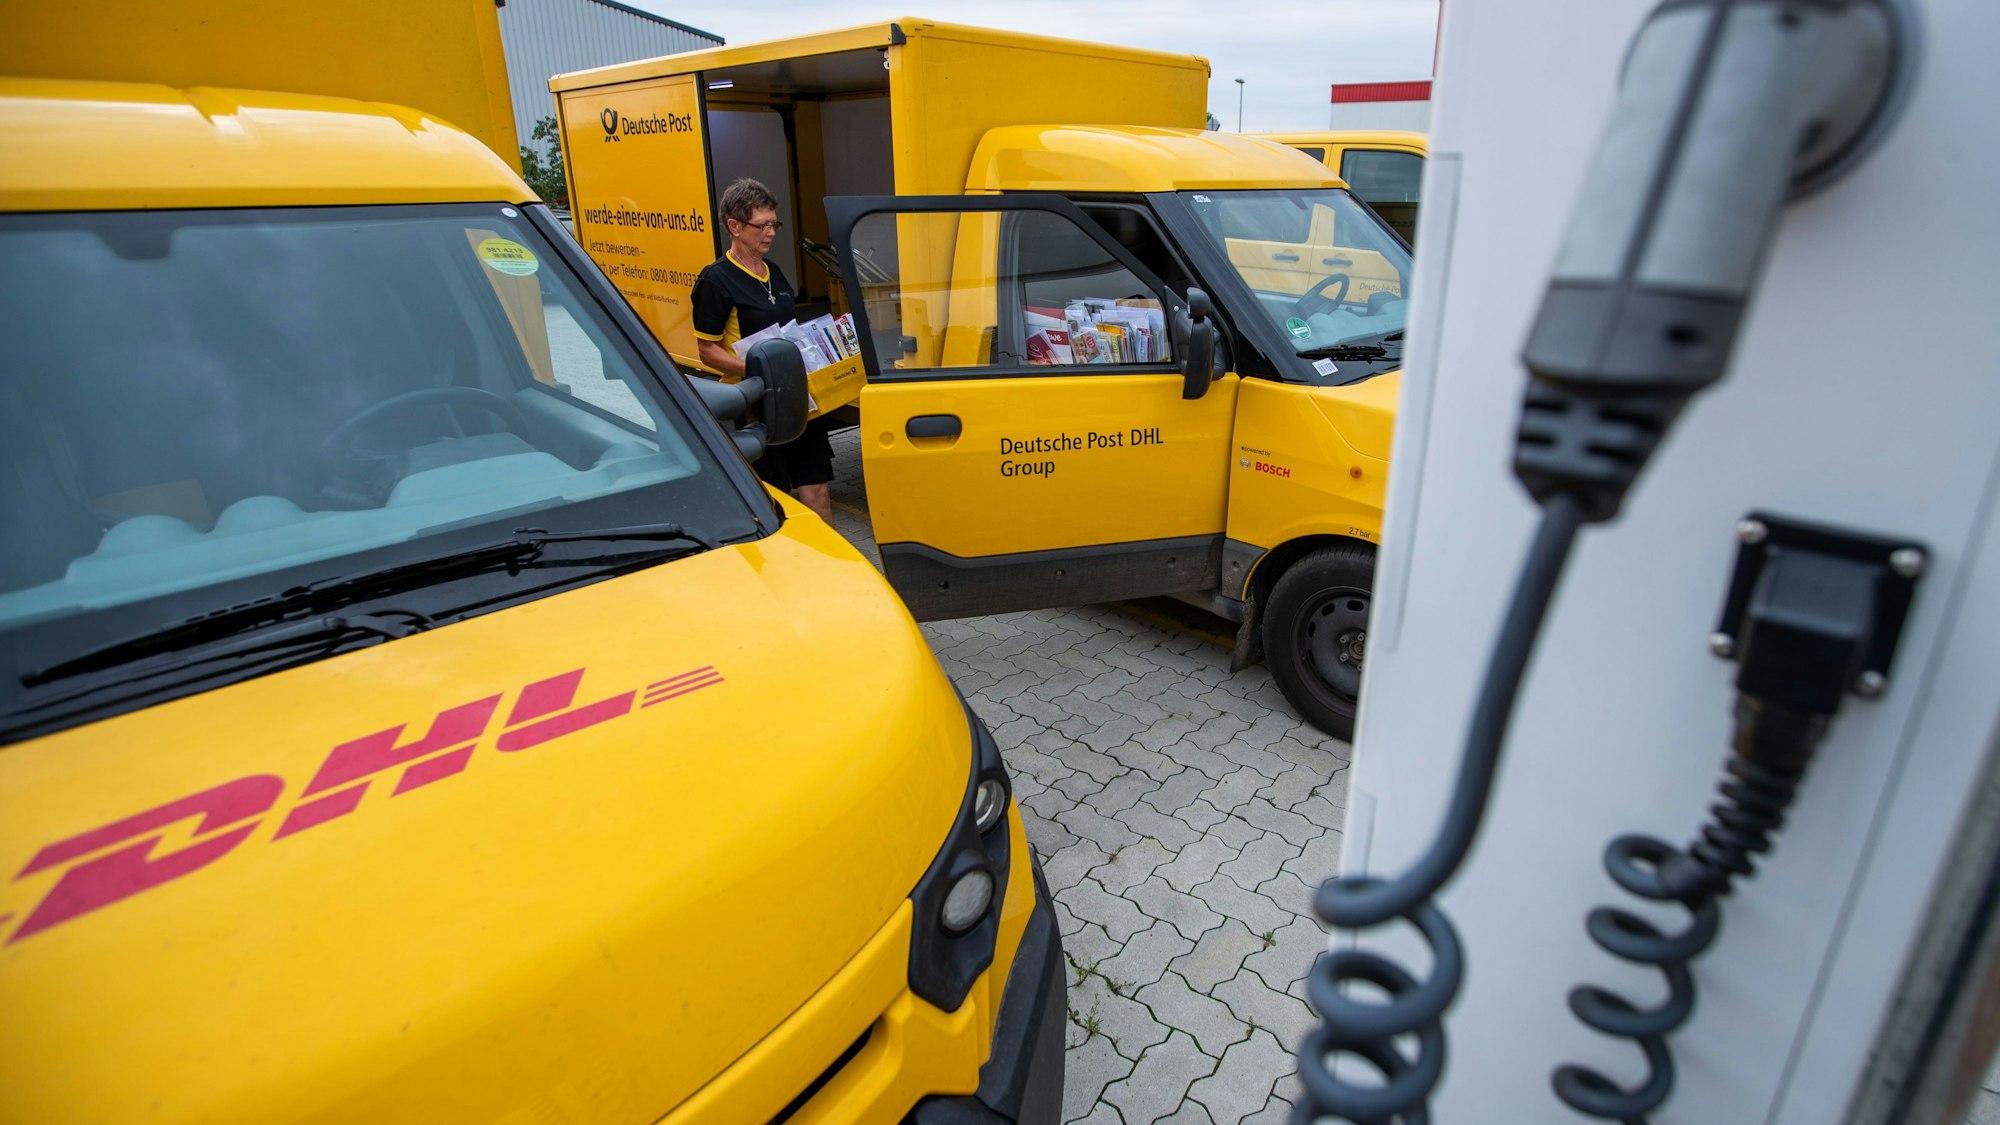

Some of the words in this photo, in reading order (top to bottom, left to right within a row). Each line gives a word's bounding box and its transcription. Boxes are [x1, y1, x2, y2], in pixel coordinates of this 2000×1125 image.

[622, 113, 667, 135] Deutsche
[668, 112, 693, 133] Post
[584, 203, 705, 233] werde-einer-von-uns.de
[590, 240, 605, 253] Jetzt
[606, 240, 640, 257] bewerben
[620, 263, 649, 280] Telefon:
[650, 268, 668, 283] 0800
[669, 270, 699, 287] 801033
[1001, 432, 1082, 455] Deutsche
[1088, 431, 1123, 449] Post
[1131, 427, 1164, 446] DHL
[1001, 460, 1055, 479] Group
[1255, 461, 1291, 479] BOSCH
[3, 667, 637, 947] DHL
